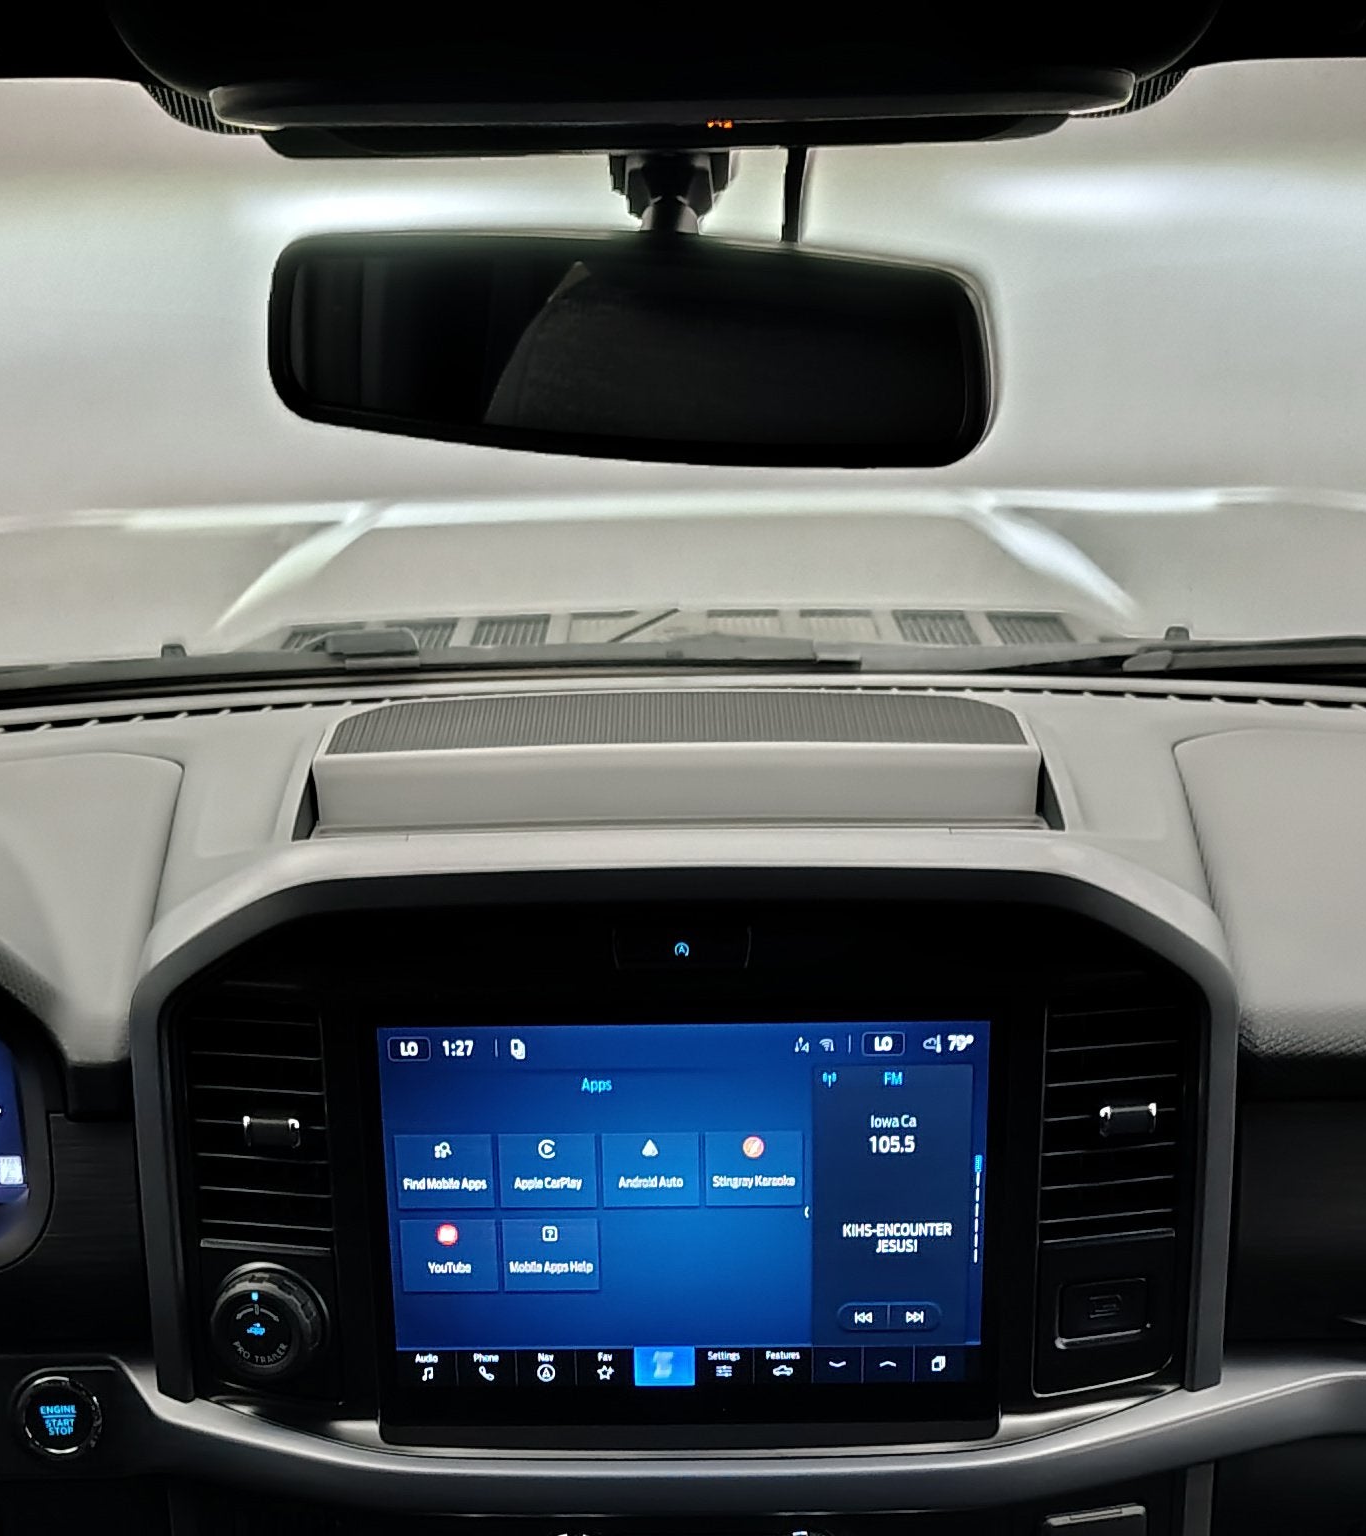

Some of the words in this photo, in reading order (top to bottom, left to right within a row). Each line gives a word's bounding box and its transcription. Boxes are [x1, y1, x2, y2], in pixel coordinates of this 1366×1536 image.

[399, 1041, 419, 1057] LO
[442, 1040, 474, 1057] 1:27
[873, 1036, 893, 1052] LO
[581, 1077, 613, 1094] Apps
[883, 1072, 903, 1086] FM
[870, 1115, 899, 1129] Iowa
[900, 1114, 917, 1128] Ca
[869, 1135, 916, 1154] 105.5
[403, 1178, 426, 1191] Find
[426, 1178, 460, 1191] Mobile
[461, 1178, 488, 1192] Apps
[514, 1177, 544, 1191] Apple
[544, 1177, 583, 1192] CarPlay
[618, 1176, 658, 1189] Android
[659, 1176, 683, 1188] Auto
[712, 1176, 754, 1189] Stingray
[754, 1175, 796, 1188] Karaoke
[842, 1223, 952, 1238] KIHS-ENCOUNTER
[428, 1261, 472, 1274] YouTube
[509, 1261, 543, 1274] Mobile
[544, 1261, 569, 1274] Apps
[570, 1261, 594, 1274] Help
[415, 1353, 438, 1364] Audio
[473, 1352, 499, 1364] Phone
[537, 1353, 554, 1363] Nav
[597, 1352, 613, 1362] Fav
[707, 1351, 740, 1362] Settings
[765, 1350, 800, 1361] Features
[39, 1404, 77, 1415] ENGINE
[44, 1418, 75, 1428] START
[48, 1426, 74, 1436] STOP
